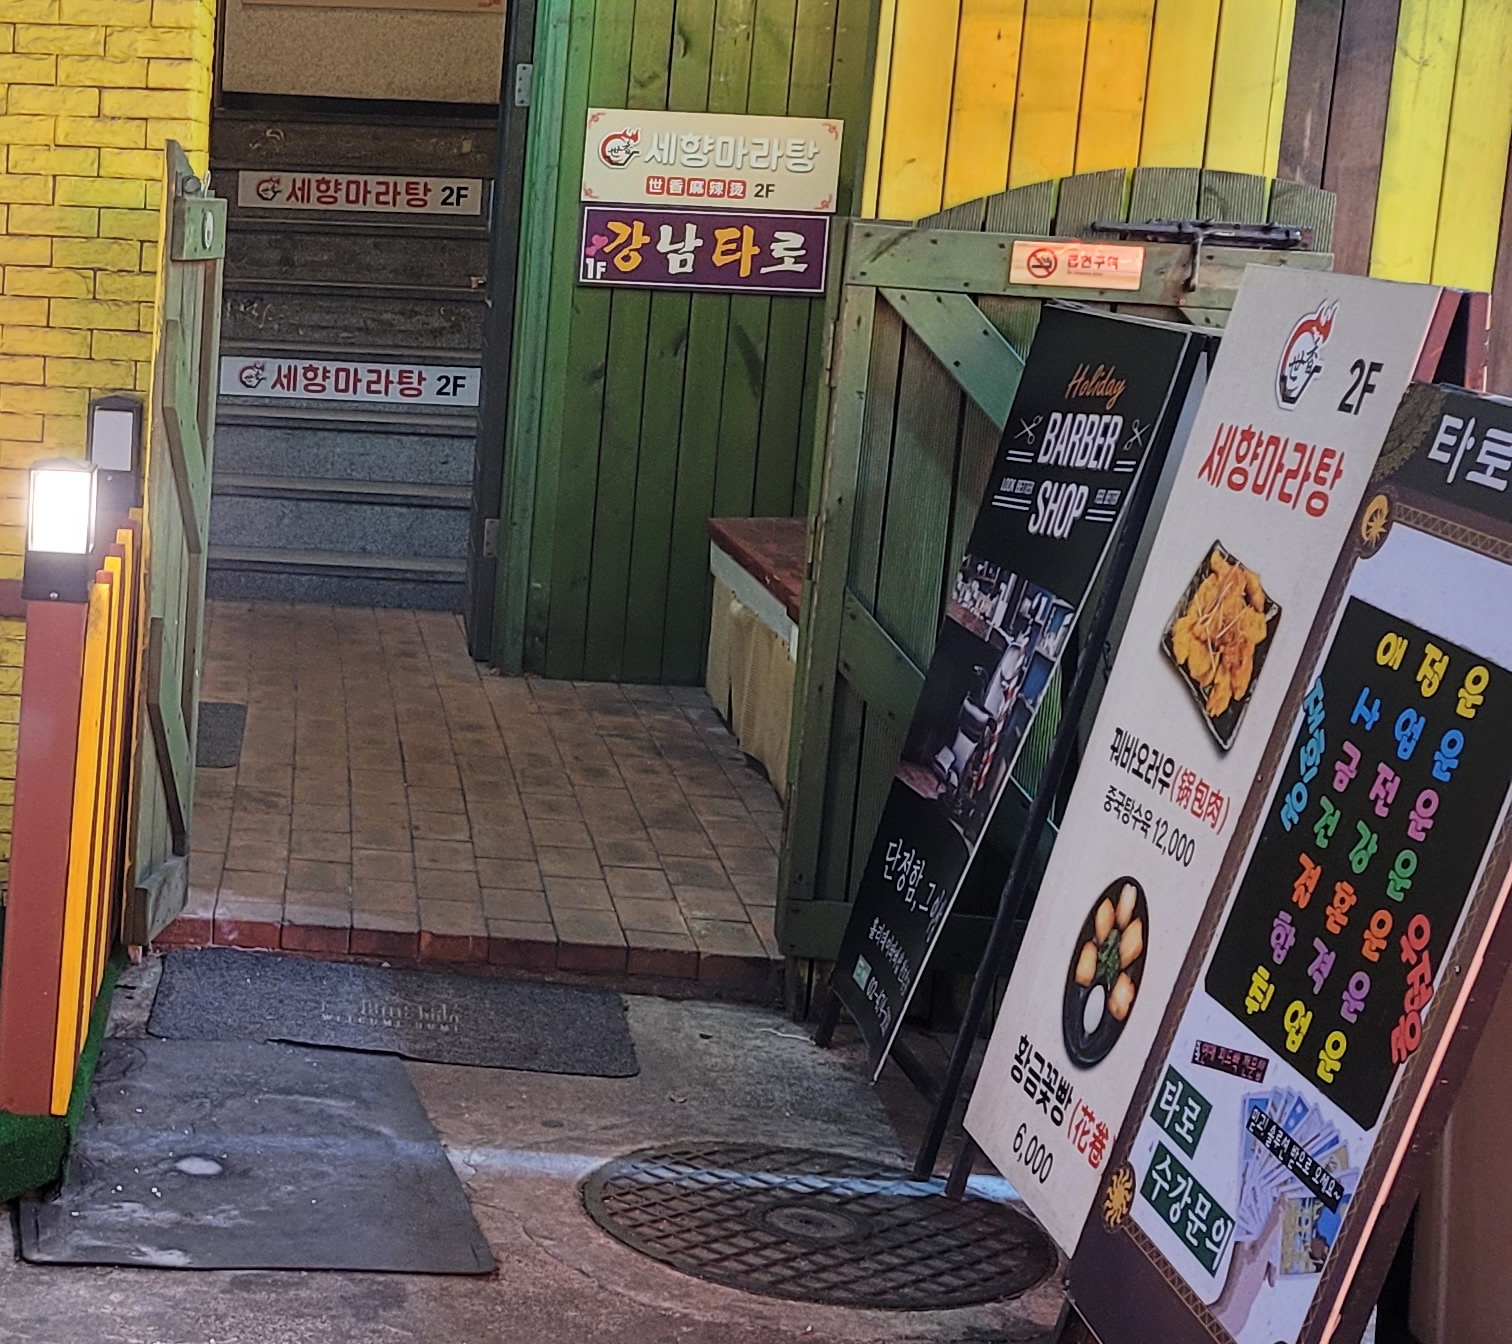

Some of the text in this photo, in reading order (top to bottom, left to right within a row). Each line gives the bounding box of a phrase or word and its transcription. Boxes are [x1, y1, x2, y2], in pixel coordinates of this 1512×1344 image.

[644, 132, 820, 173] 세향마라탕
[286, 176, 433, 208] 세향마라탕
[439, 185, 470, 208] 2F
[753, 183, 777, 199] 2F
[585, 257, 608, 280] 1F
[603, 219, 809, 279] 강남타로
[1067, 253, 1120, 271] 금연구역
[271, 363, 428, 399] 세향마라탕
[435, 374, 468, 398] 2F
[1064, 362, 1127, 411] Holiday
[1336, 358, 1385, 416] 2F
[1037, 411, 1125, 472] BARBER
[1197, 422, 1346, 518] 세향마라탕
[1427, 414, 1512, 492] 타로
[1027, 479, 1090, 540] SHOP
[1103, 784, 1196, 868] 중국탕수육 12,000
[1159, 1079, 1202, 1145] 타로
[1011, 1121, 1055, 1185] 6,000
[1150, 1153, 1234, 1272] 수강문의
